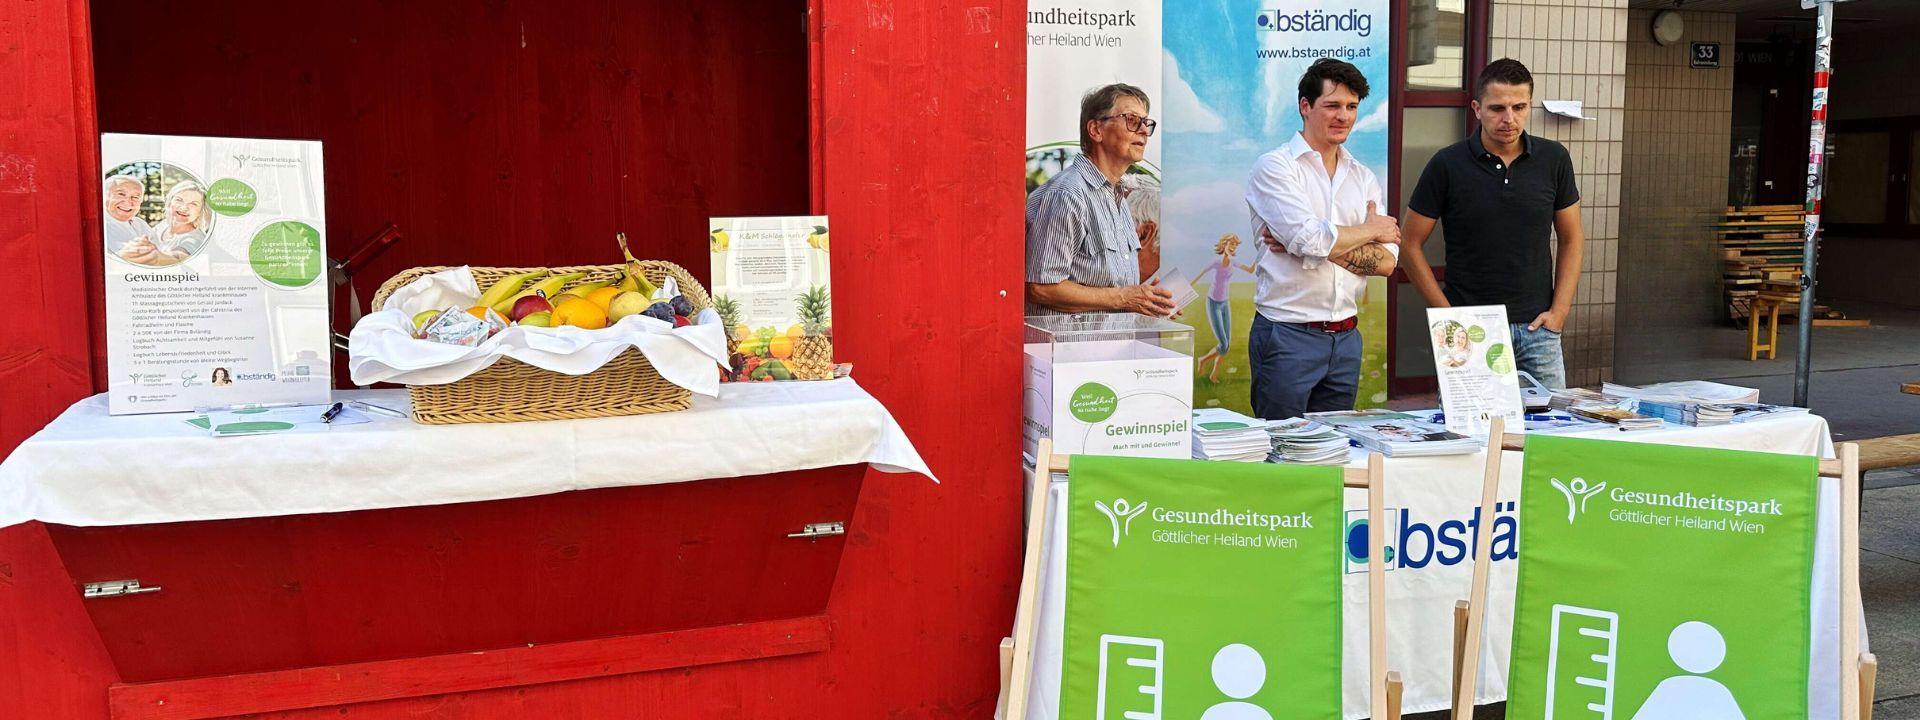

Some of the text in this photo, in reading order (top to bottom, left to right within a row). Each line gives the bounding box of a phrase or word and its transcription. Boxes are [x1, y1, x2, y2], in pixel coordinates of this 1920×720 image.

[1276, 8, 1371, 37] bständig
[1049, 33, 1091, 47] Heiland
[1093, 34, 1122, 48] Wien
[1256, 46, 1371, 60] www.bstaendig.at
[1698, 45, 1714, 58] 33
[124, 272, 200, 284] Gewinnspiel
[1105, 419, 1187, 437] Gewinnspiel
[1610, 487, 1784, 516] Gesundheitspark
[1151, 506, 1314, 531] Gesundheitspark
[1609, 508, 1765, 535] Göttlicher Heiland Wien
[1151, 529, 1298, 549] Göttlicher Heiland Wien
